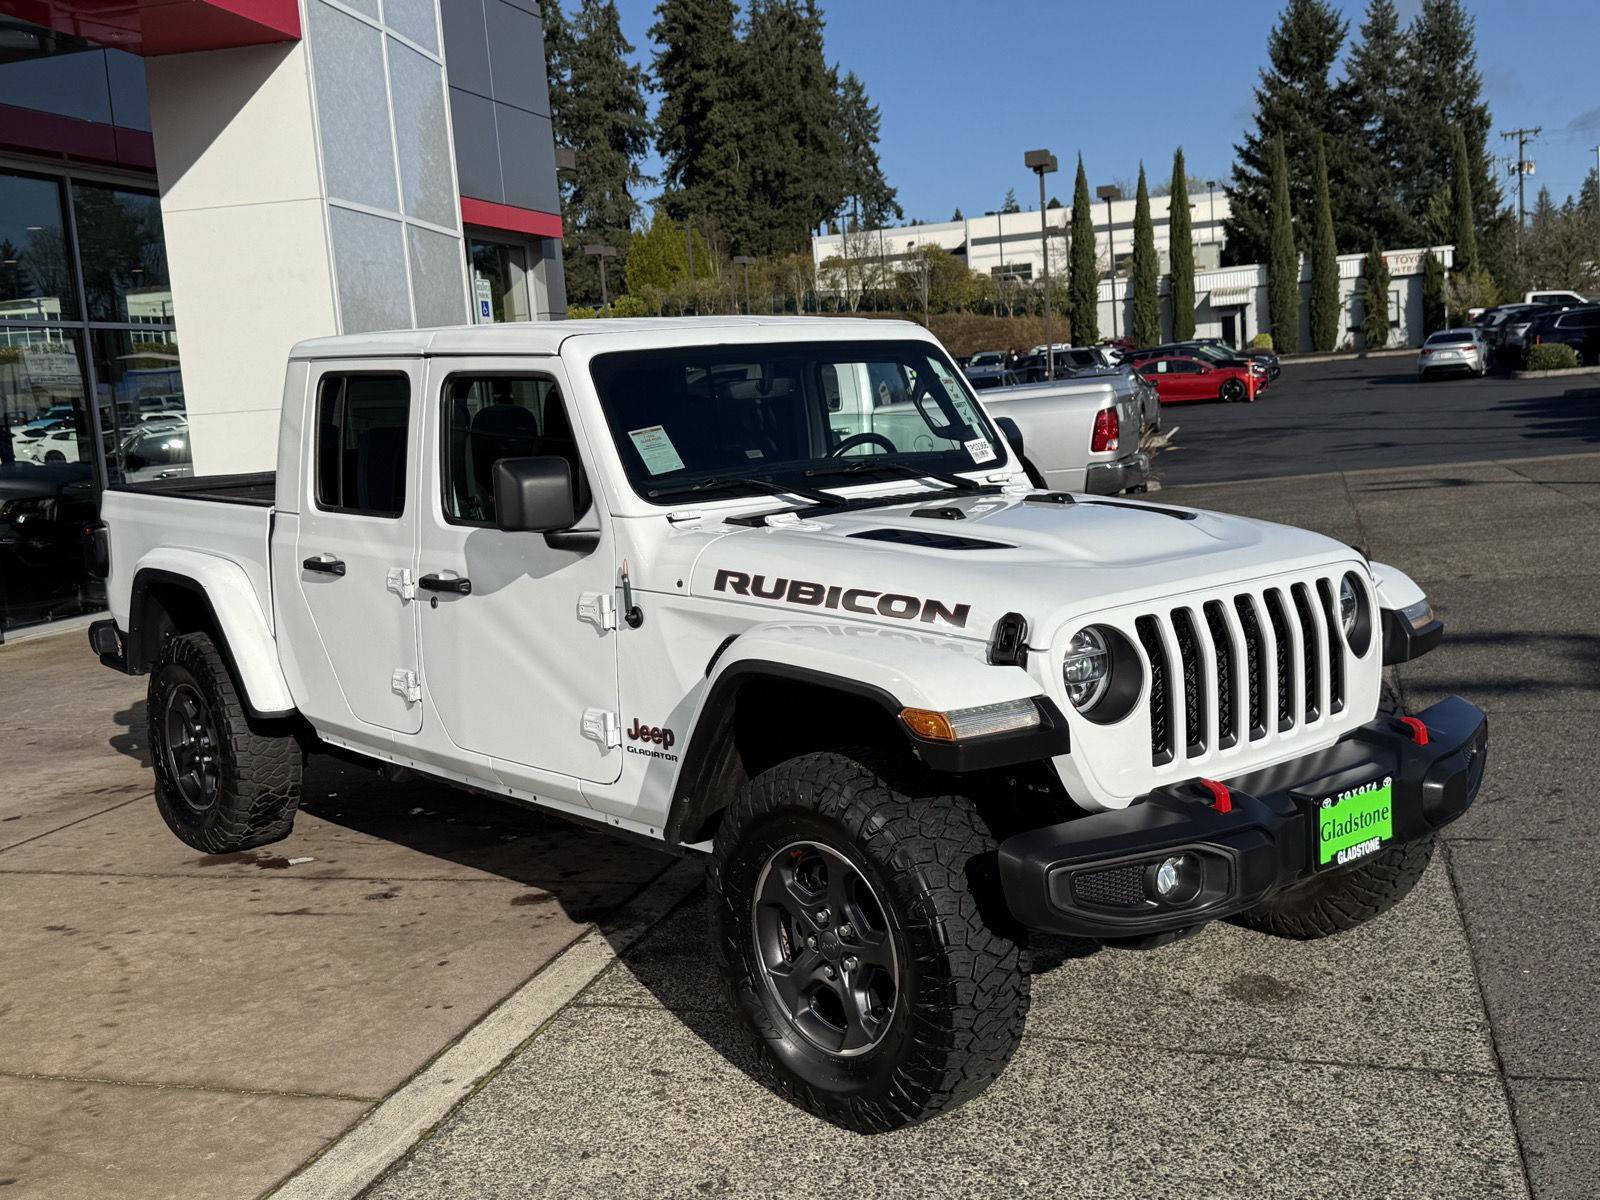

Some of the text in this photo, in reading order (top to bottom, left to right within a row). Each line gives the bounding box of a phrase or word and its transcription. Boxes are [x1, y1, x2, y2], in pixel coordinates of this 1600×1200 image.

[713, 569, 972, 628] RUBICON
[627, 717, 675, 750] Jeep
[626, 745, 678, 762] GLADIATOR
[1338, 782, 1377, 801] TOYOTA
[1321, 806, 1389, 842] Gladstone
[1337, 836, 1380, 865] GLADSTONE
